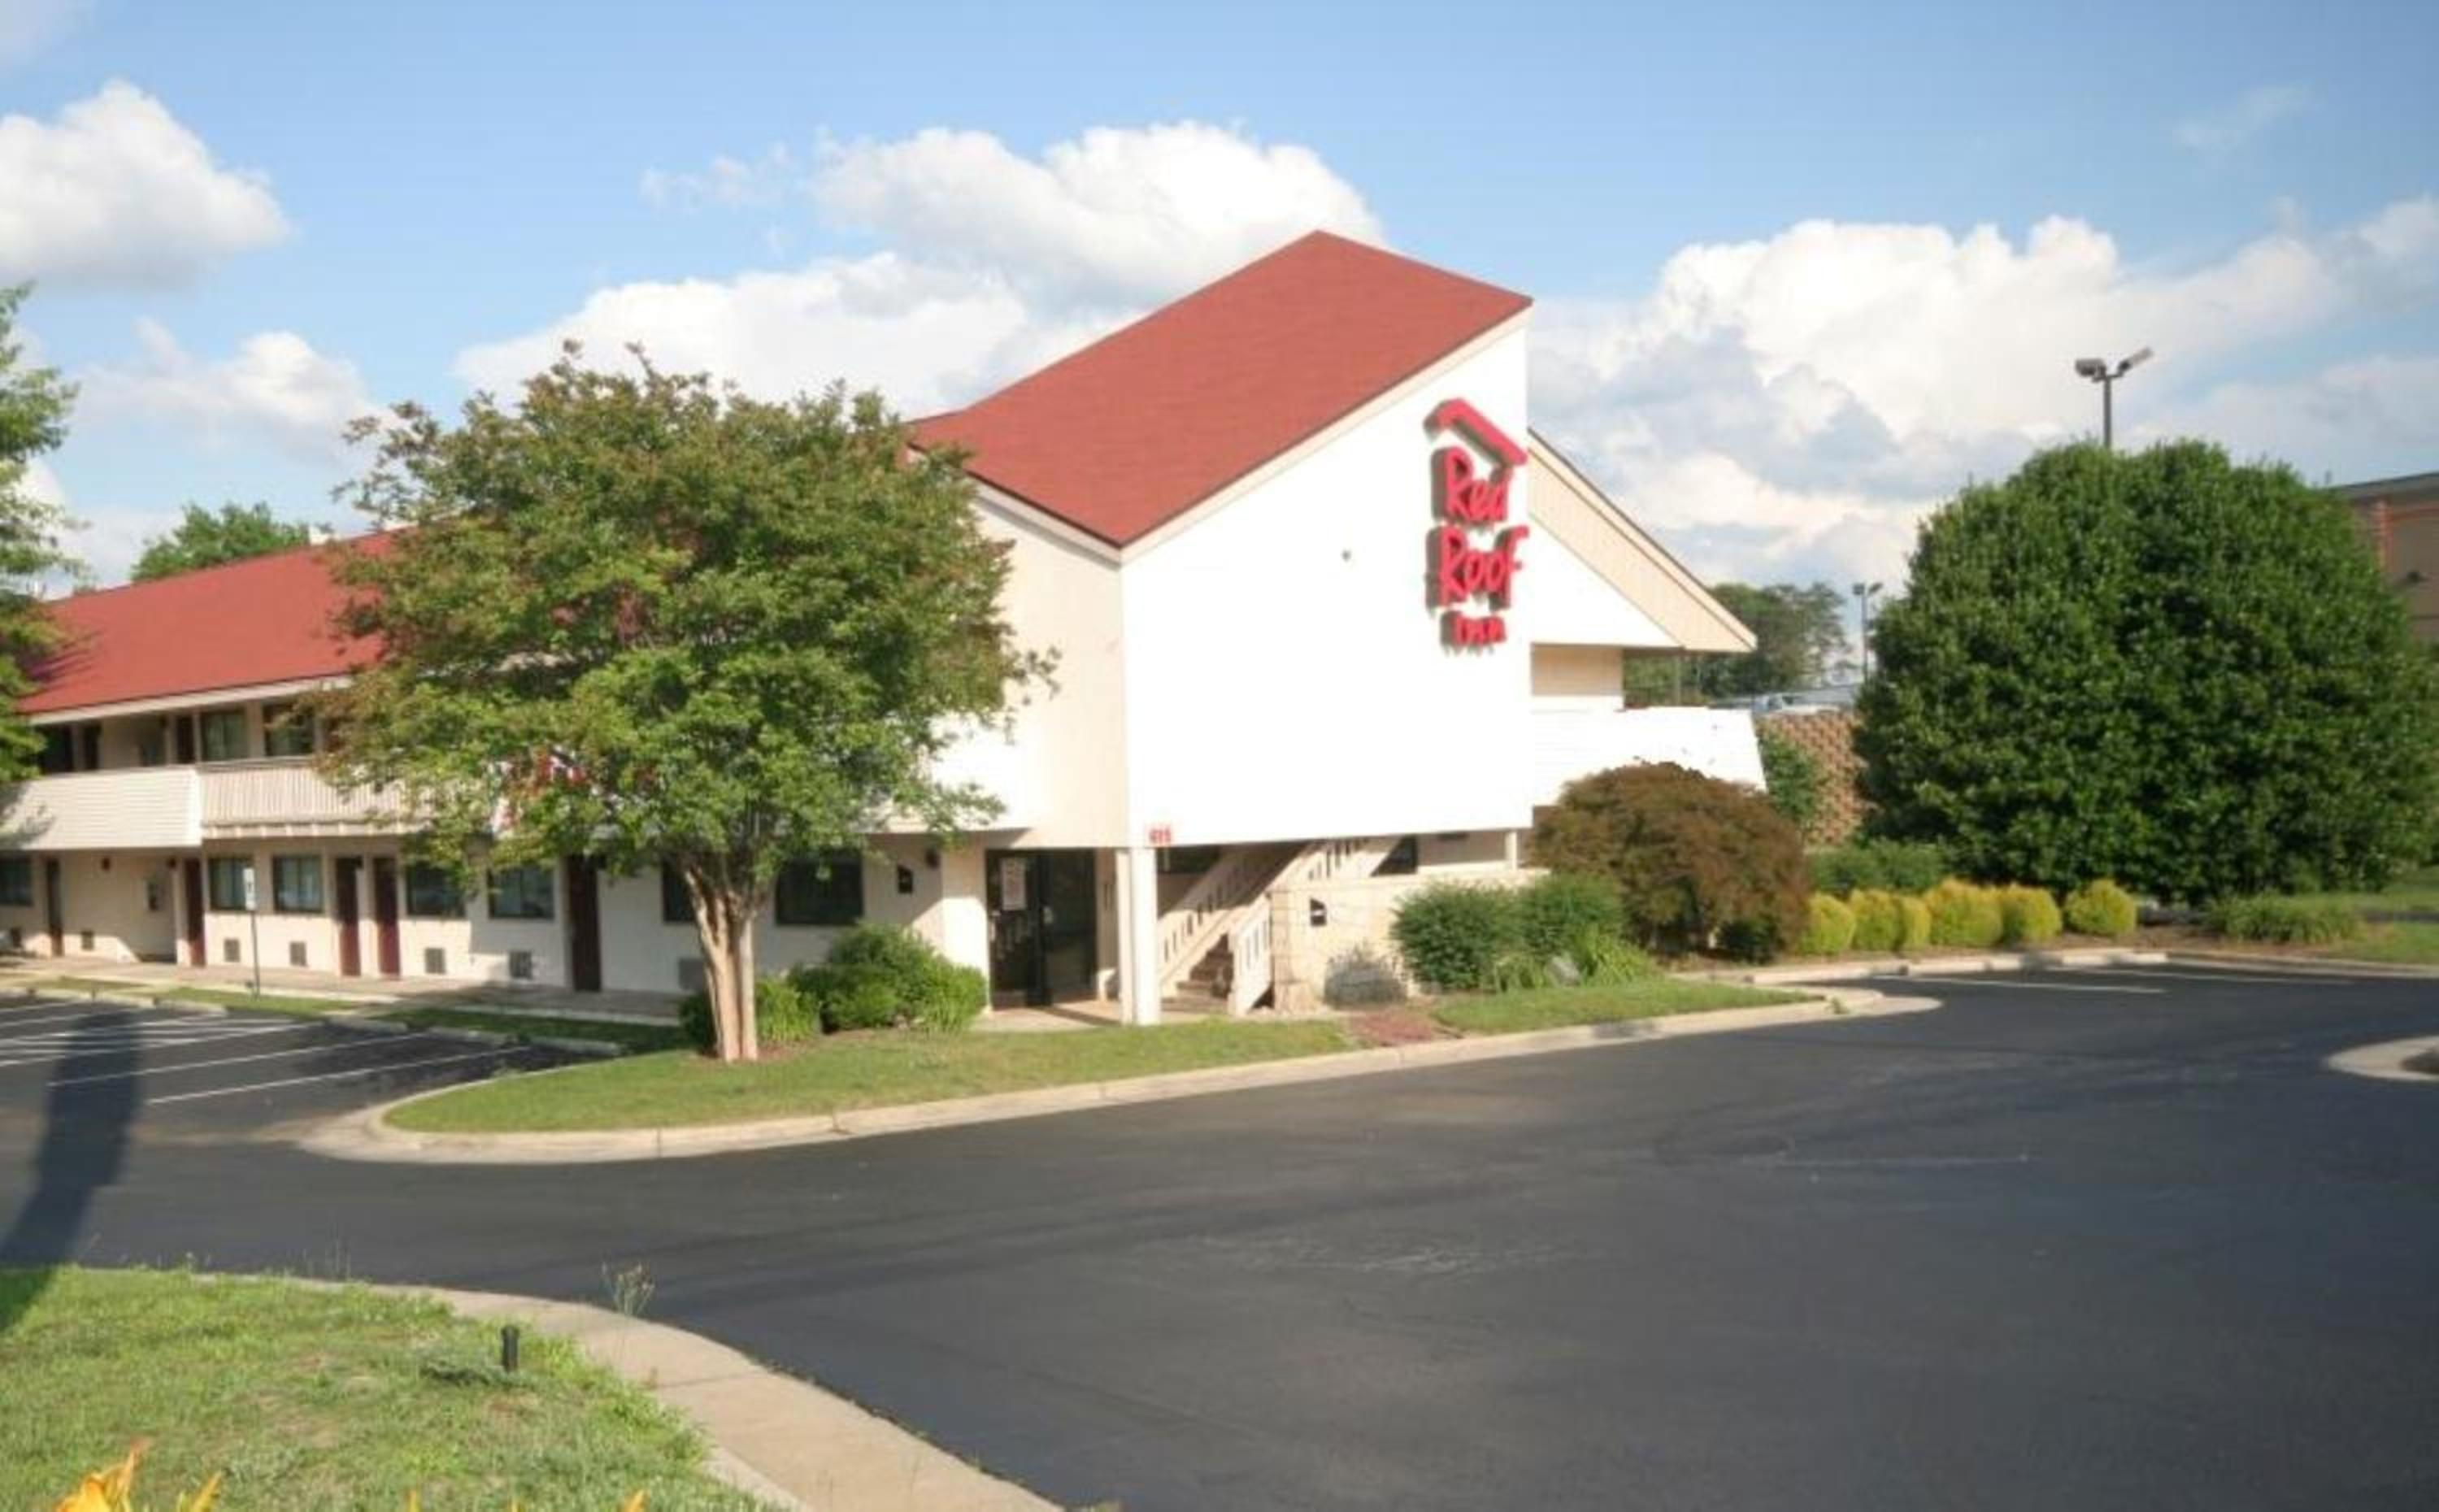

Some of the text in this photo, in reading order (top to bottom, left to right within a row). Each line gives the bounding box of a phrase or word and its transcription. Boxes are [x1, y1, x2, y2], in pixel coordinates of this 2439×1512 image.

[1437, 445, 1513, 524] Red
[1432, 525, 1529, 608] Roof
[1446, 611, 1507, 648] Inn
